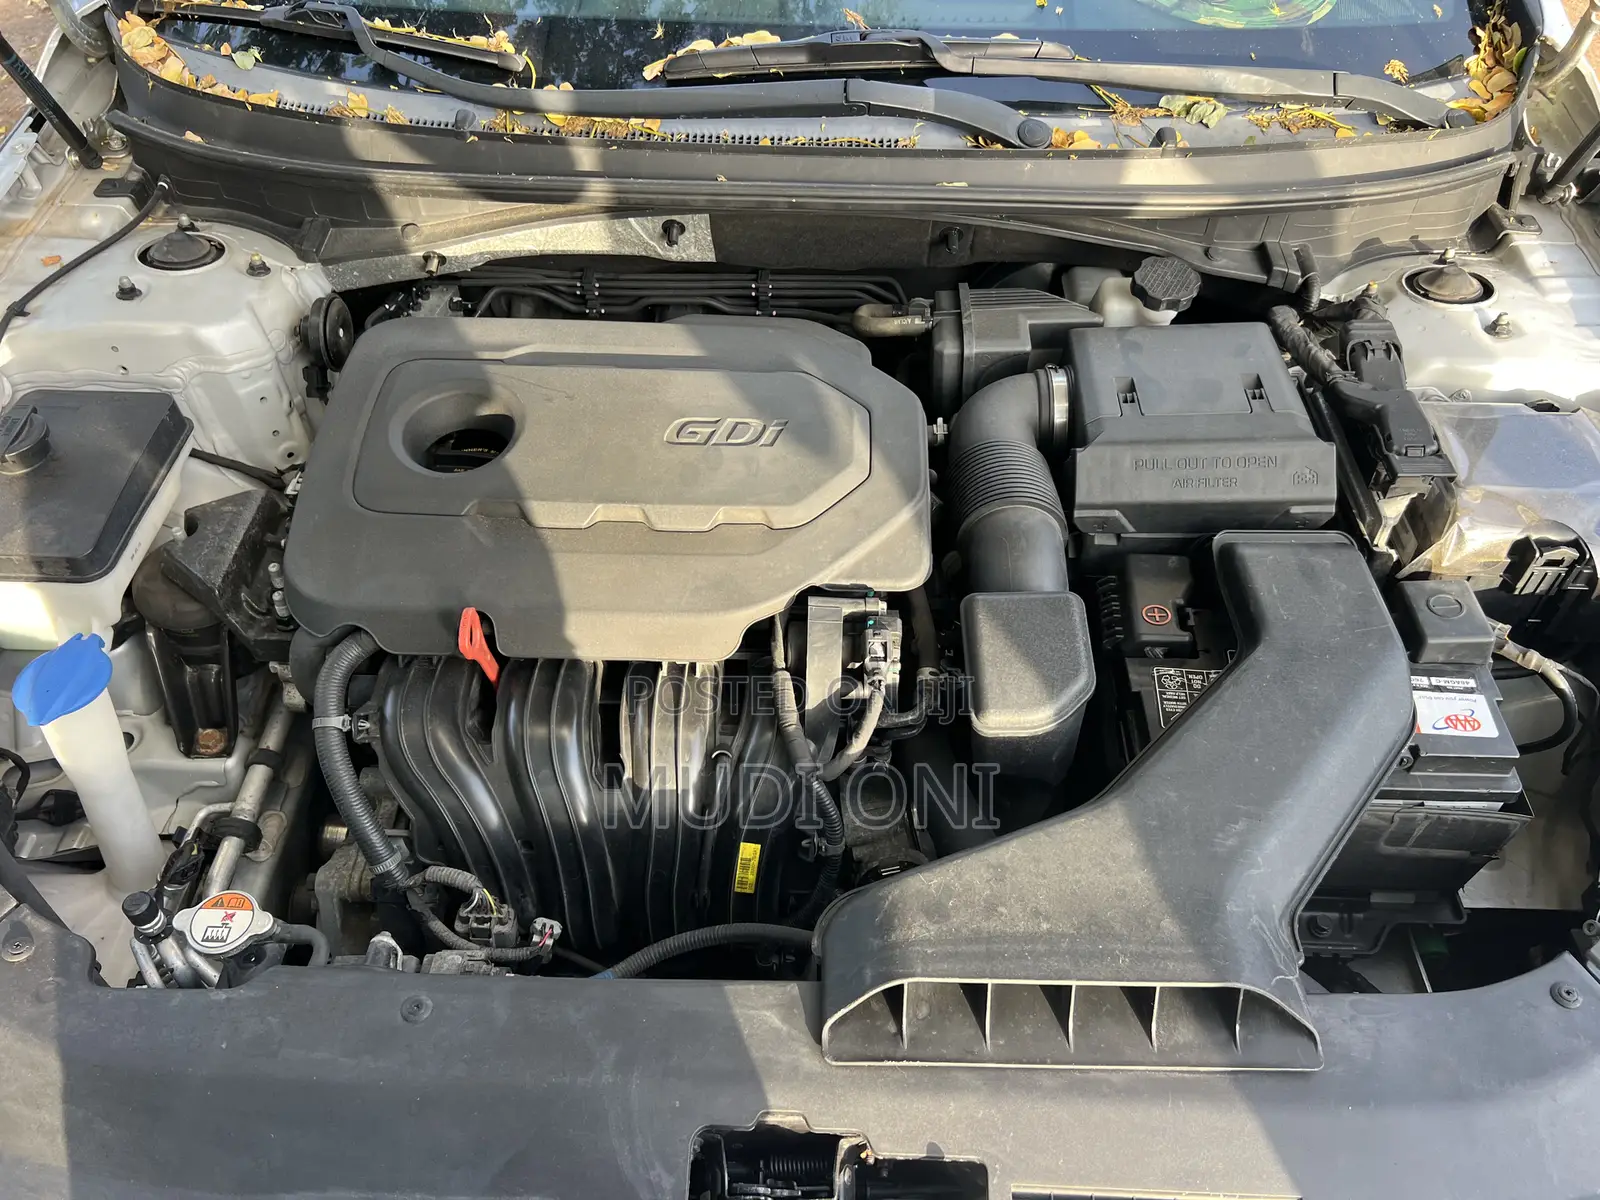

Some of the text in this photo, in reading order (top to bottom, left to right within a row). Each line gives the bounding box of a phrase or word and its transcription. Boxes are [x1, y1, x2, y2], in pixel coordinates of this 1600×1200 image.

[663, 416, 790, 448] GDi
[1134, 455, 1278, 471] PULL OUT TO OPEN
[1173, 476, 1238, 489] AIR FILTER
[1446, 714, 1480, 732] AAA
